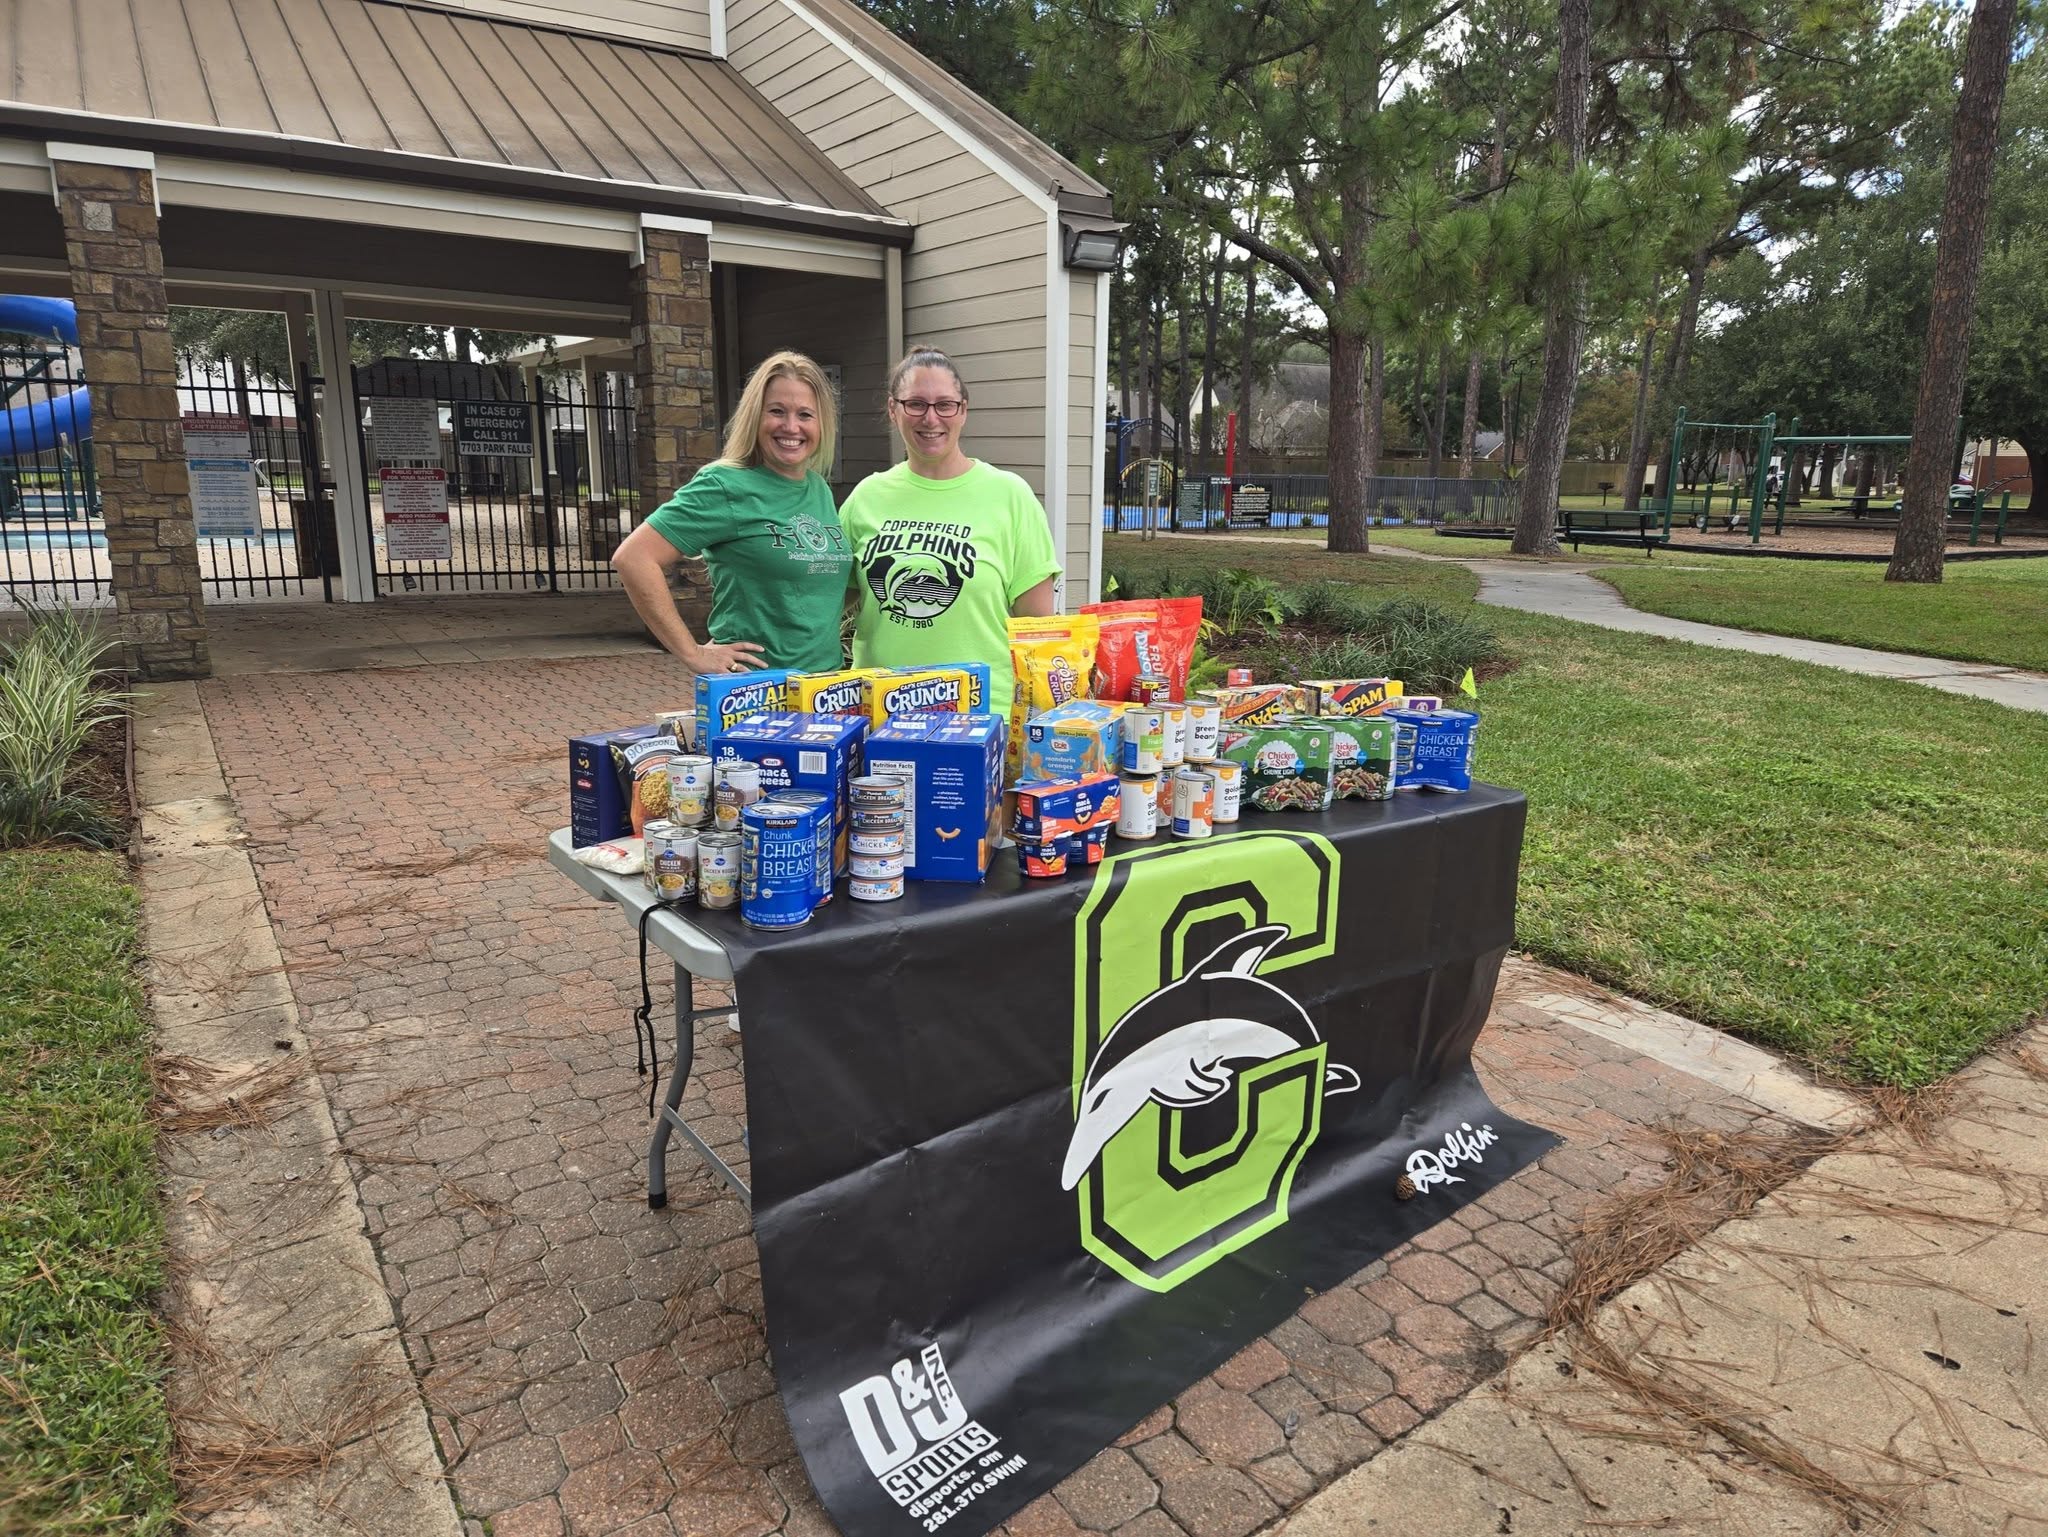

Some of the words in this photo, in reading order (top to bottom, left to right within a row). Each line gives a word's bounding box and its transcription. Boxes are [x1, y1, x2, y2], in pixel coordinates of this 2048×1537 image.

[466, 404, 478, 415] IN
[480, 406, 506, 416] CASE
[508, 407, 522, 417] OF
[464, 417, 526, 430] EMERGENCY
[473, 430, 498, 440] CALL
[500, 431, 518, 441] 911
[461, 442, 482, 452] 7703
[484, 443, 506, 454] PARK
[507, 444, 532, 454] FALLS
[881, 520, 971, 538] COPPERFIELD
[862, 532, 976, 579] DOLPHINS
[889, 613, 908, 627] EST.
[912, 618, 934, 629] 1980
[814, 686, 861, 714] CRUN
[884, 680, 960, 713] CRUNCH
[1342, 686, 1384, 716] SPAM
[1032, 728, 1042, 736] 16
[1419, 734, 1464, 746] CHICKEN
[626, 744, 644, 760] 90
[644, 737, 677, 749] SECOND
[722, 746, 734, 756] 18
[1336, 742, 1357, 751] hicken
[1418, 746, 1458, 757] BREAST
[716, 754, 744, 763] pack
[1267, 751, 1296, 760] Chicken
[779, 768, 789, 778] &
[717, 790, 735, 798] CHICKEN
[764, 831, 792, 840] Chunk
[763, 856, 812, 876] BREAST
[851, 884, 878, 894] CHICKEN
[886, 1426, 992, 1502] SPORTS
[923, 1454, 1028, 1532] 281.370.SWIM
